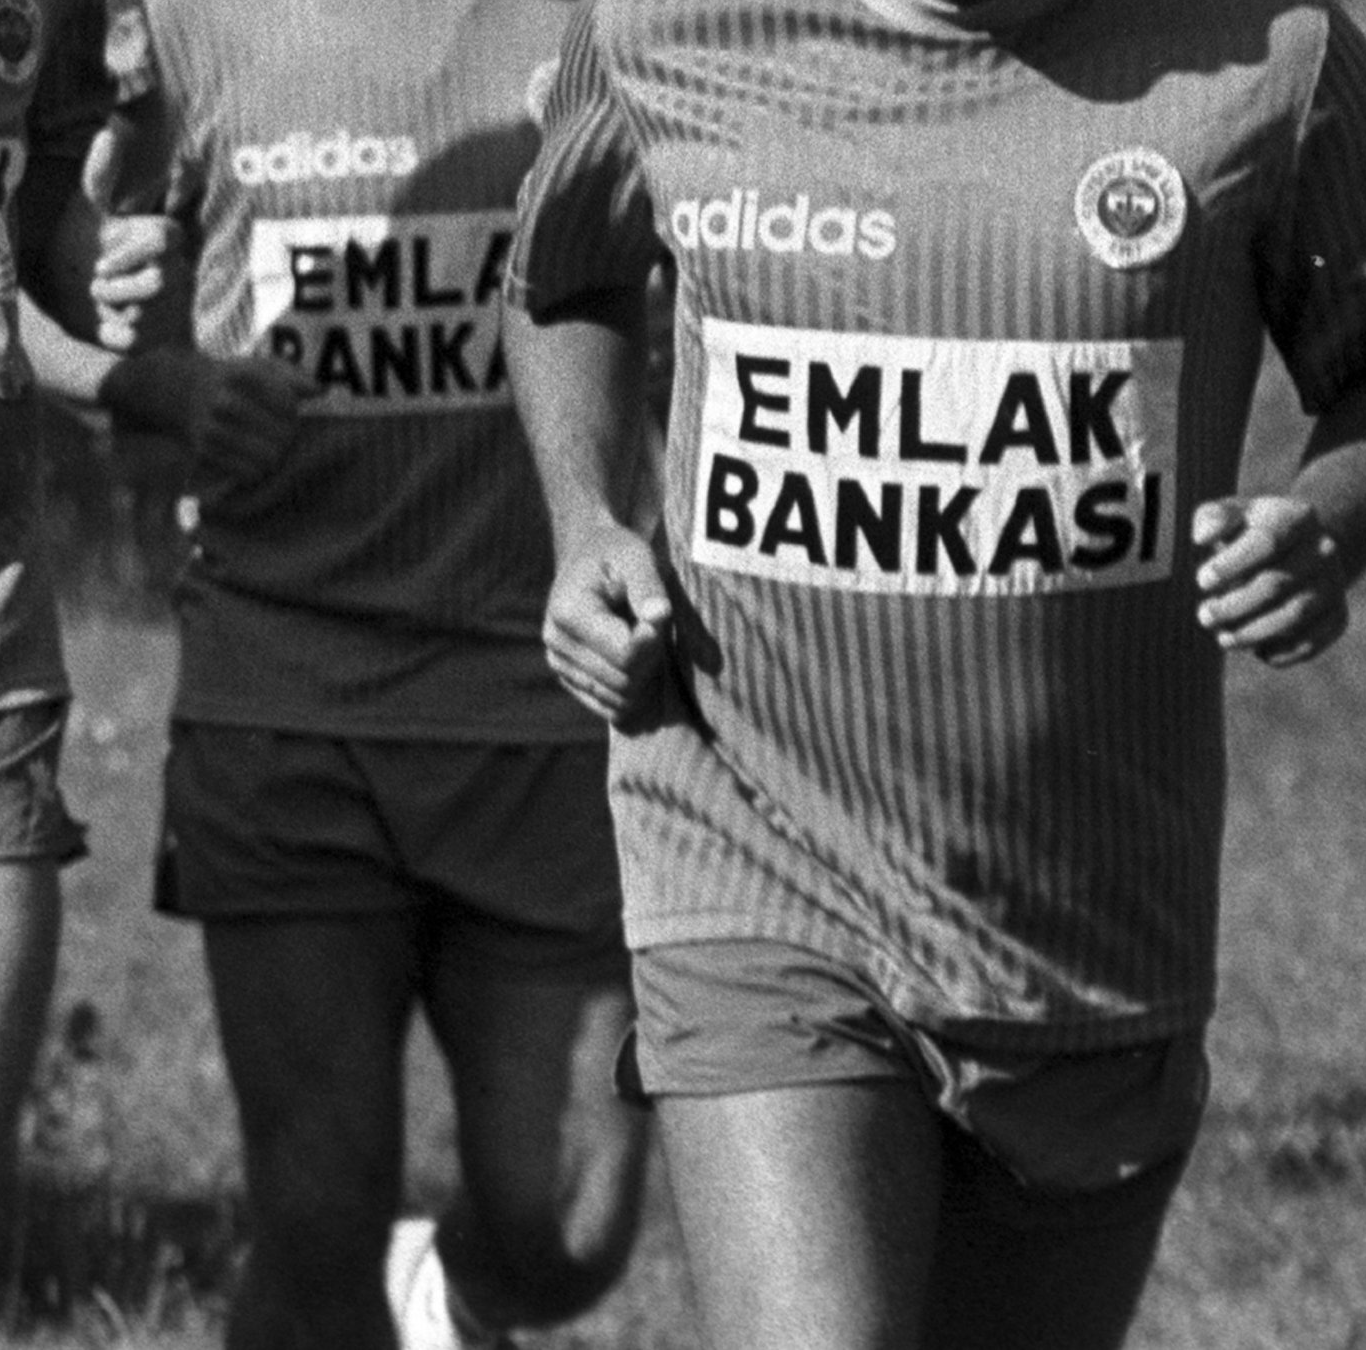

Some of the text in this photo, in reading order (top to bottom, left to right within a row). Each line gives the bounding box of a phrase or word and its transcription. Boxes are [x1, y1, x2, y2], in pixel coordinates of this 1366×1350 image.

[234, 128, 420, 186] adidas
[671, 188, 898, 260] adidas
[734, 353, 1133, 466] EMLAK
[704, 453, 1163, 577] BANKASI
